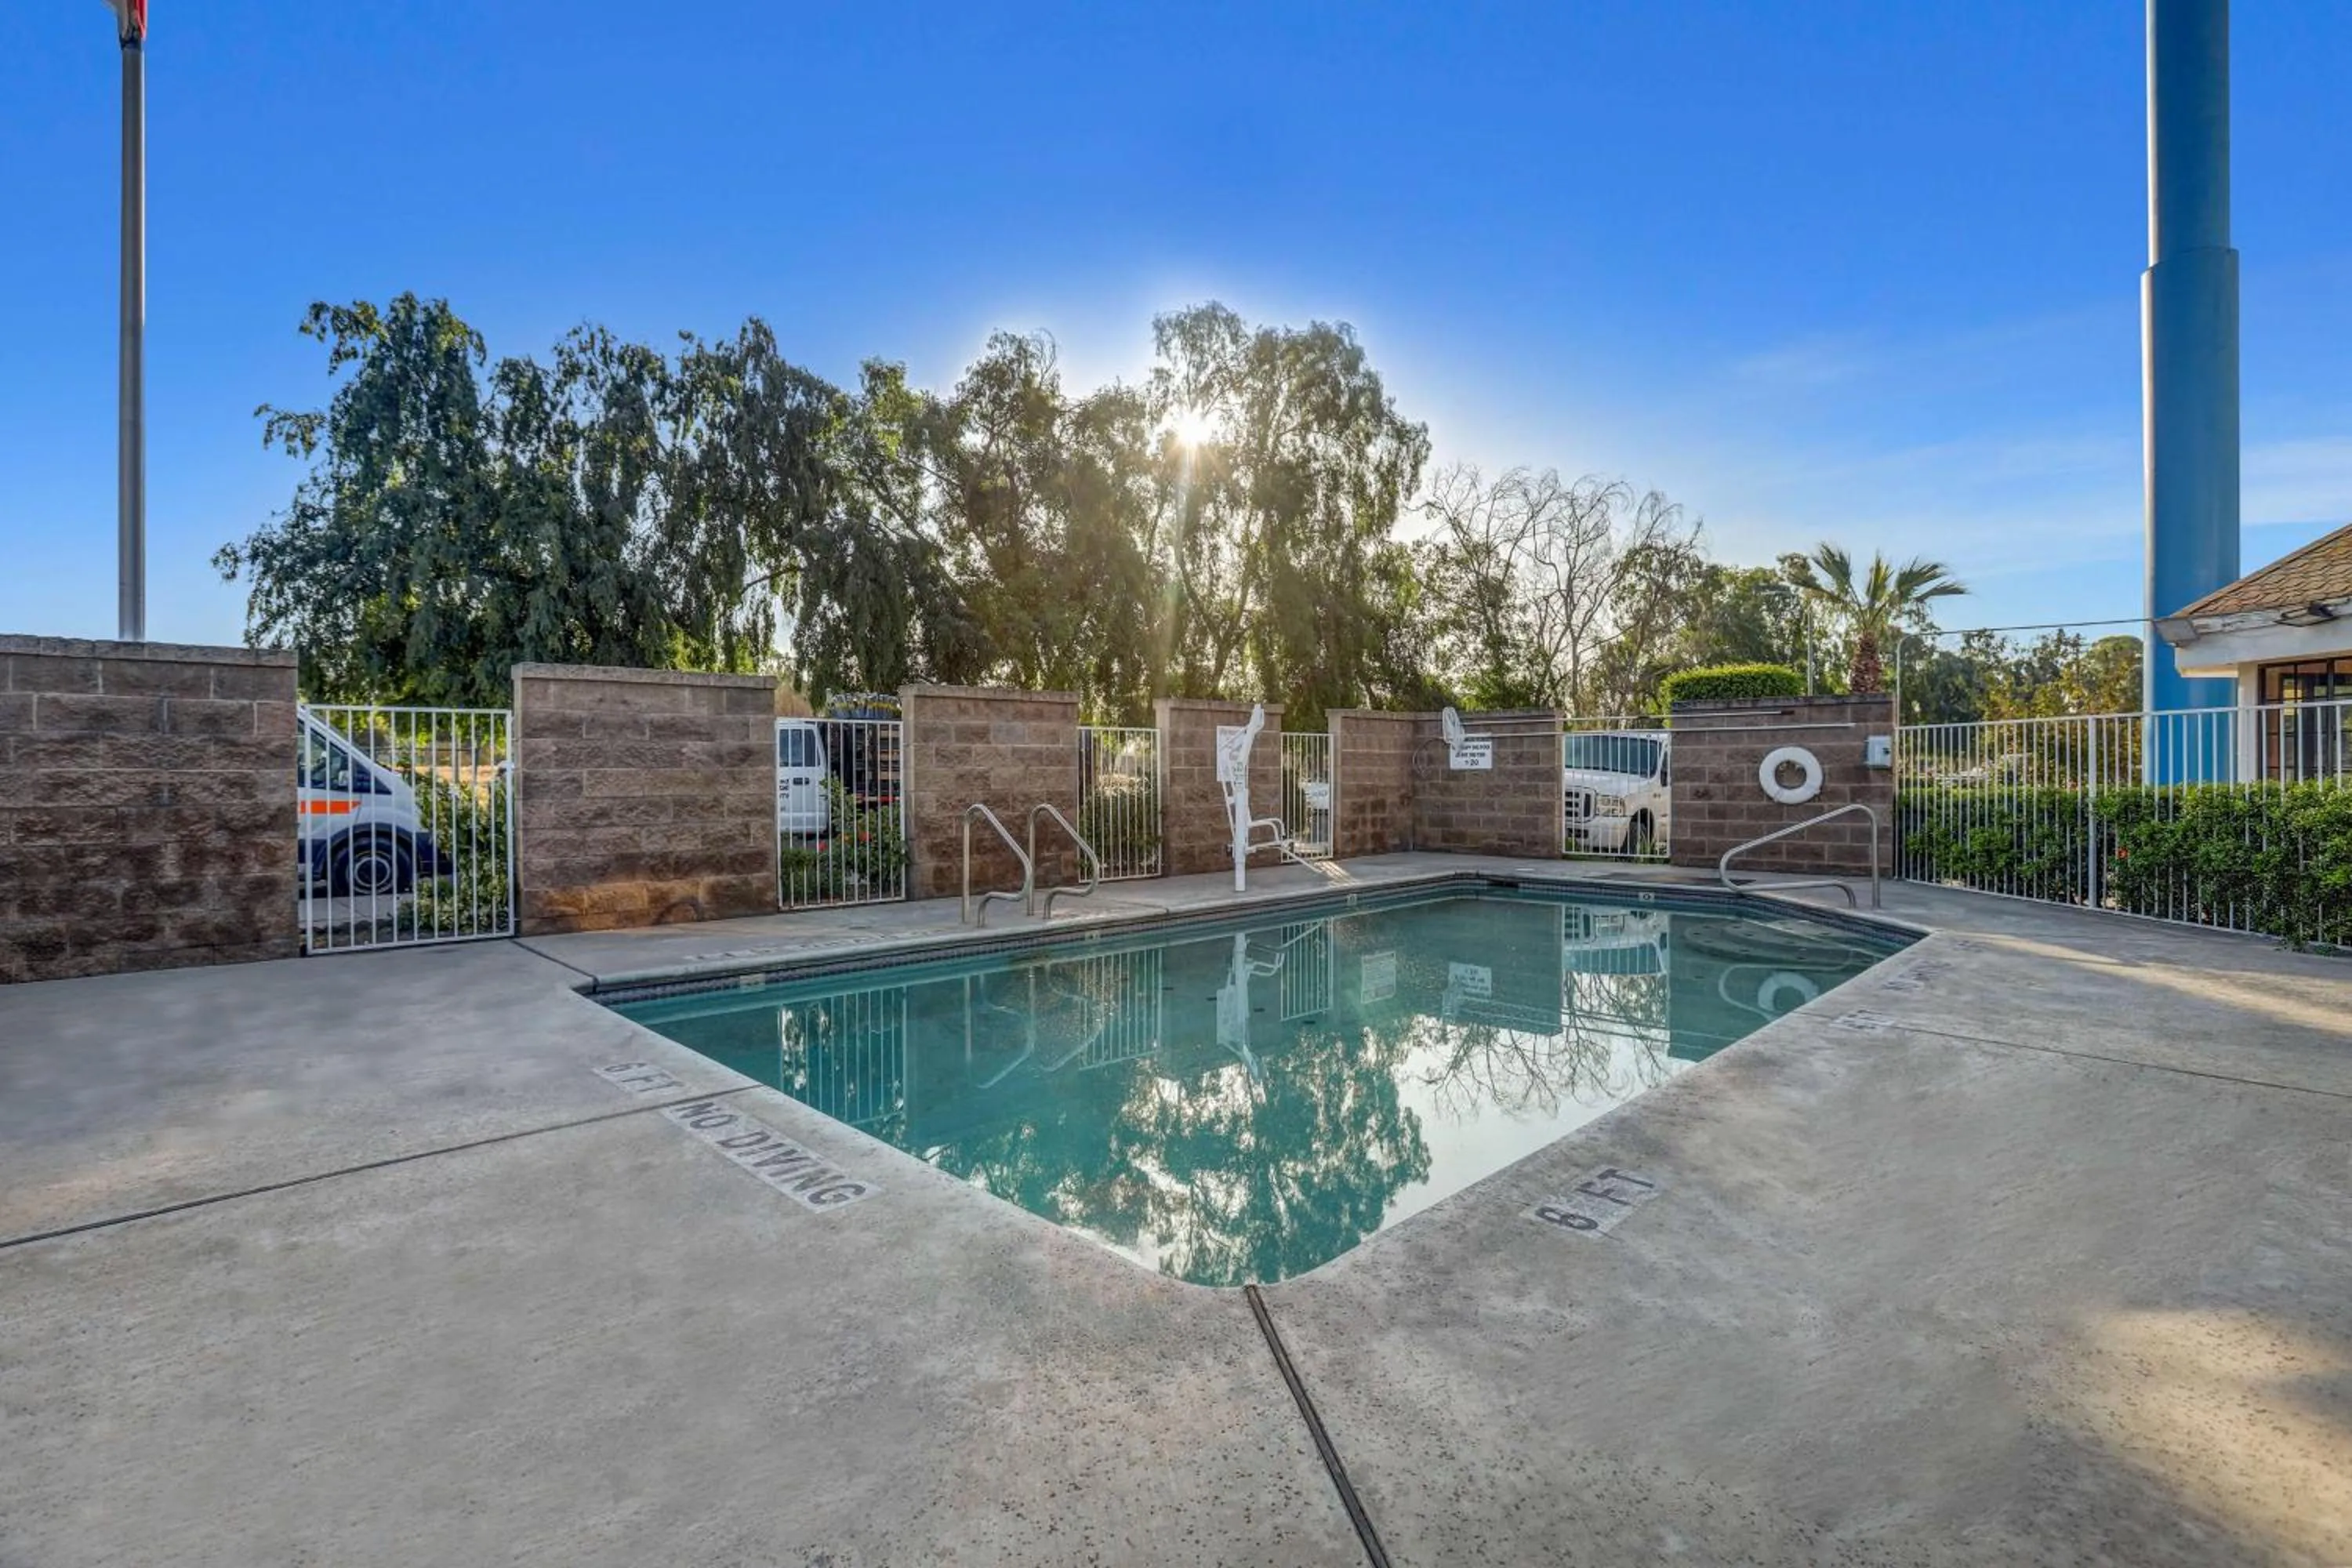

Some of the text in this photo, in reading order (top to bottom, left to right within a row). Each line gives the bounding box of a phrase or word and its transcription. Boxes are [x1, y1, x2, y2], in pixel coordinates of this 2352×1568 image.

[675, 1101, 866, 1206] NO DIVING
[1575, 1168, 1654, 1207] FT
